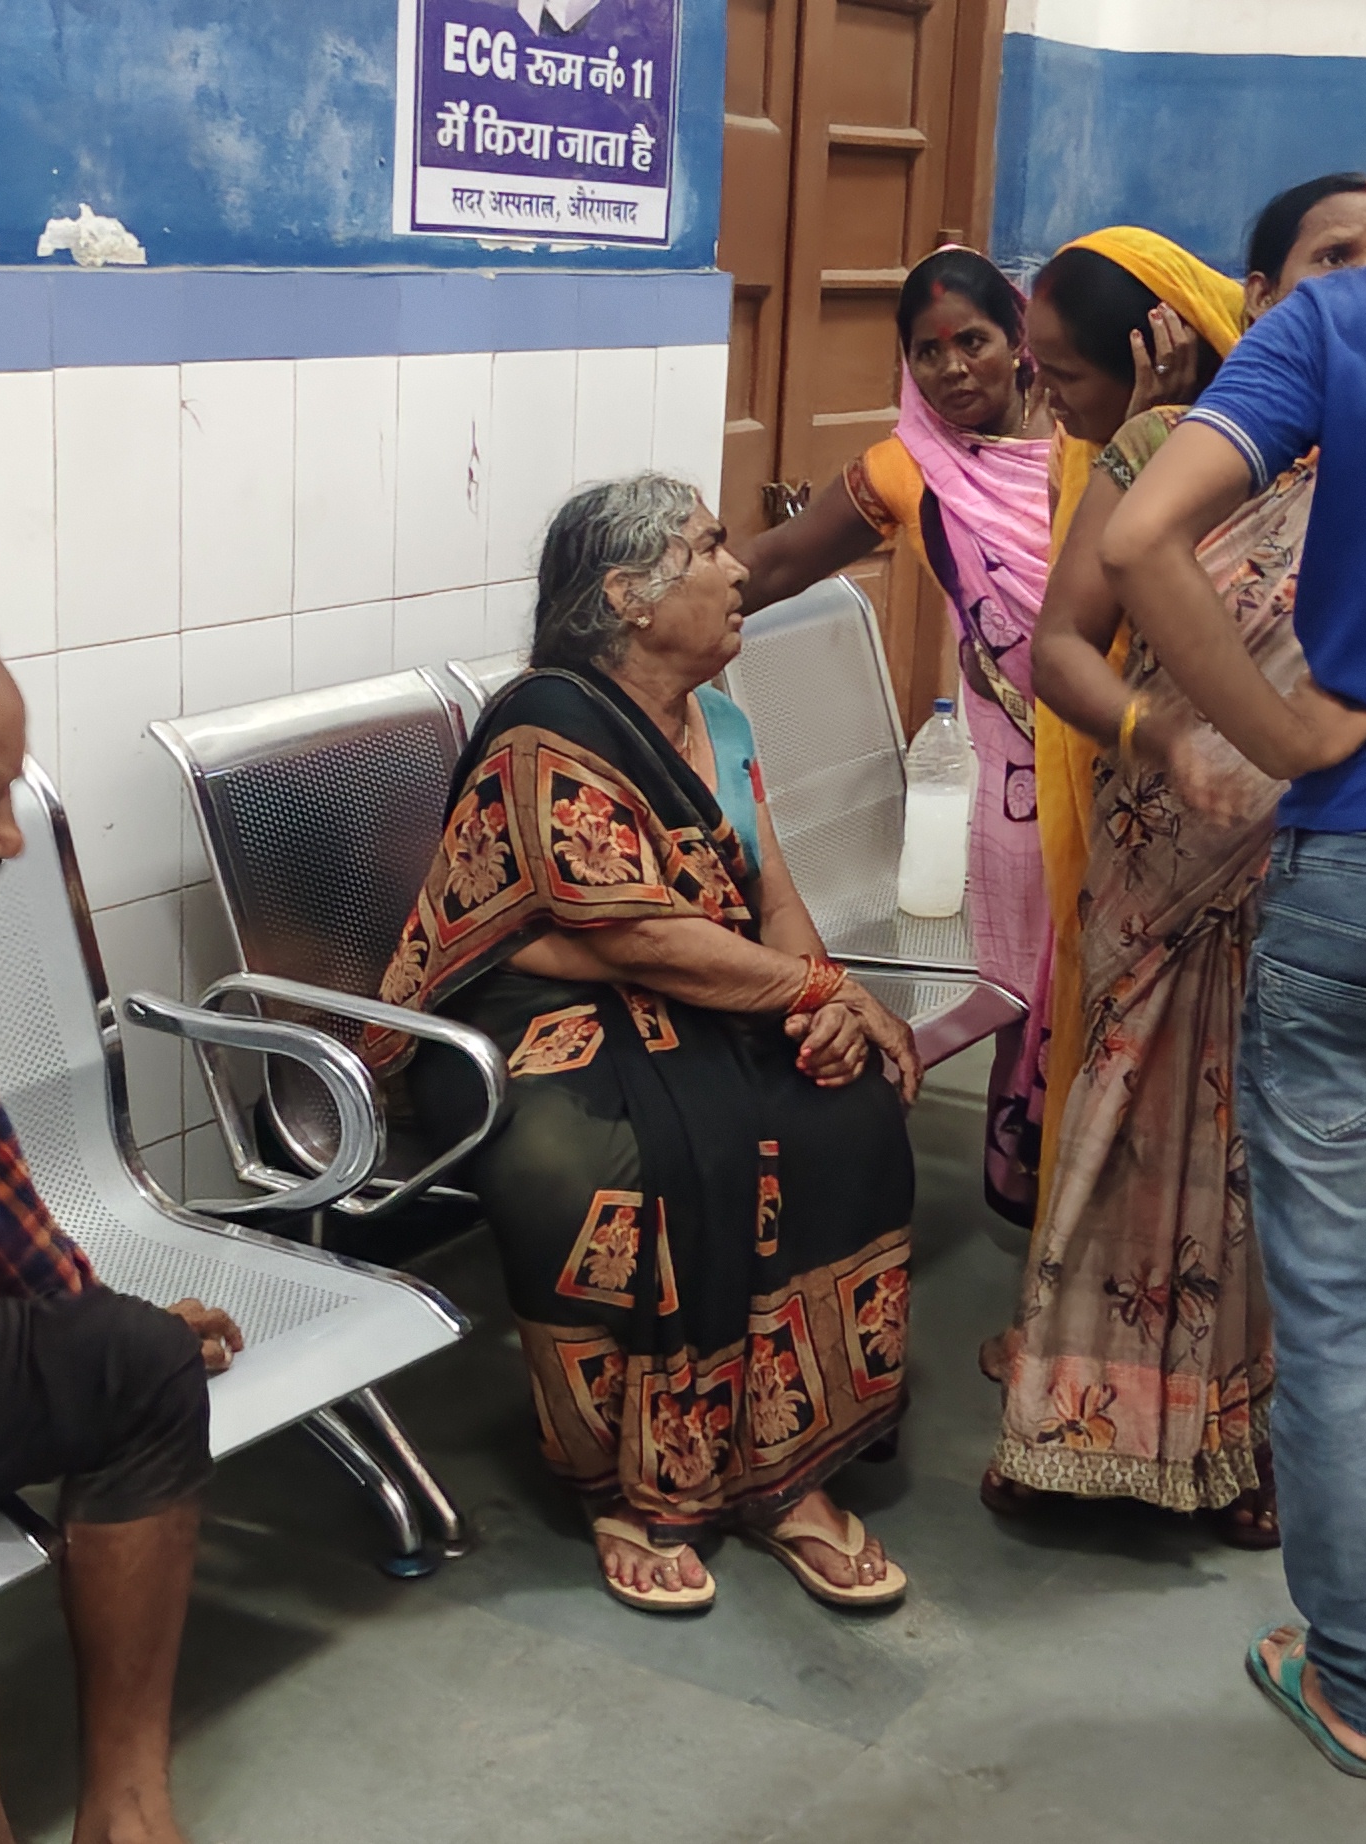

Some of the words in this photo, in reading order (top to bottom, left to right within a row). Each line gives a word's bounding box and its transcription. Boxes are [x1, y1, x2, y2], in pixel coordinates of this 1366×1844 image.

[443, 21, 517, 82] ECG
[525, 46, 586, 91] रूम
[631, 58, 654, 100] 11
[436, 99, 470, 152] में
[473, 104, 554, 161] किया
[556, 125, 628, 168] जाता
[631, 122, 656, 172] है
[452, 187, 486, 218] सदर
